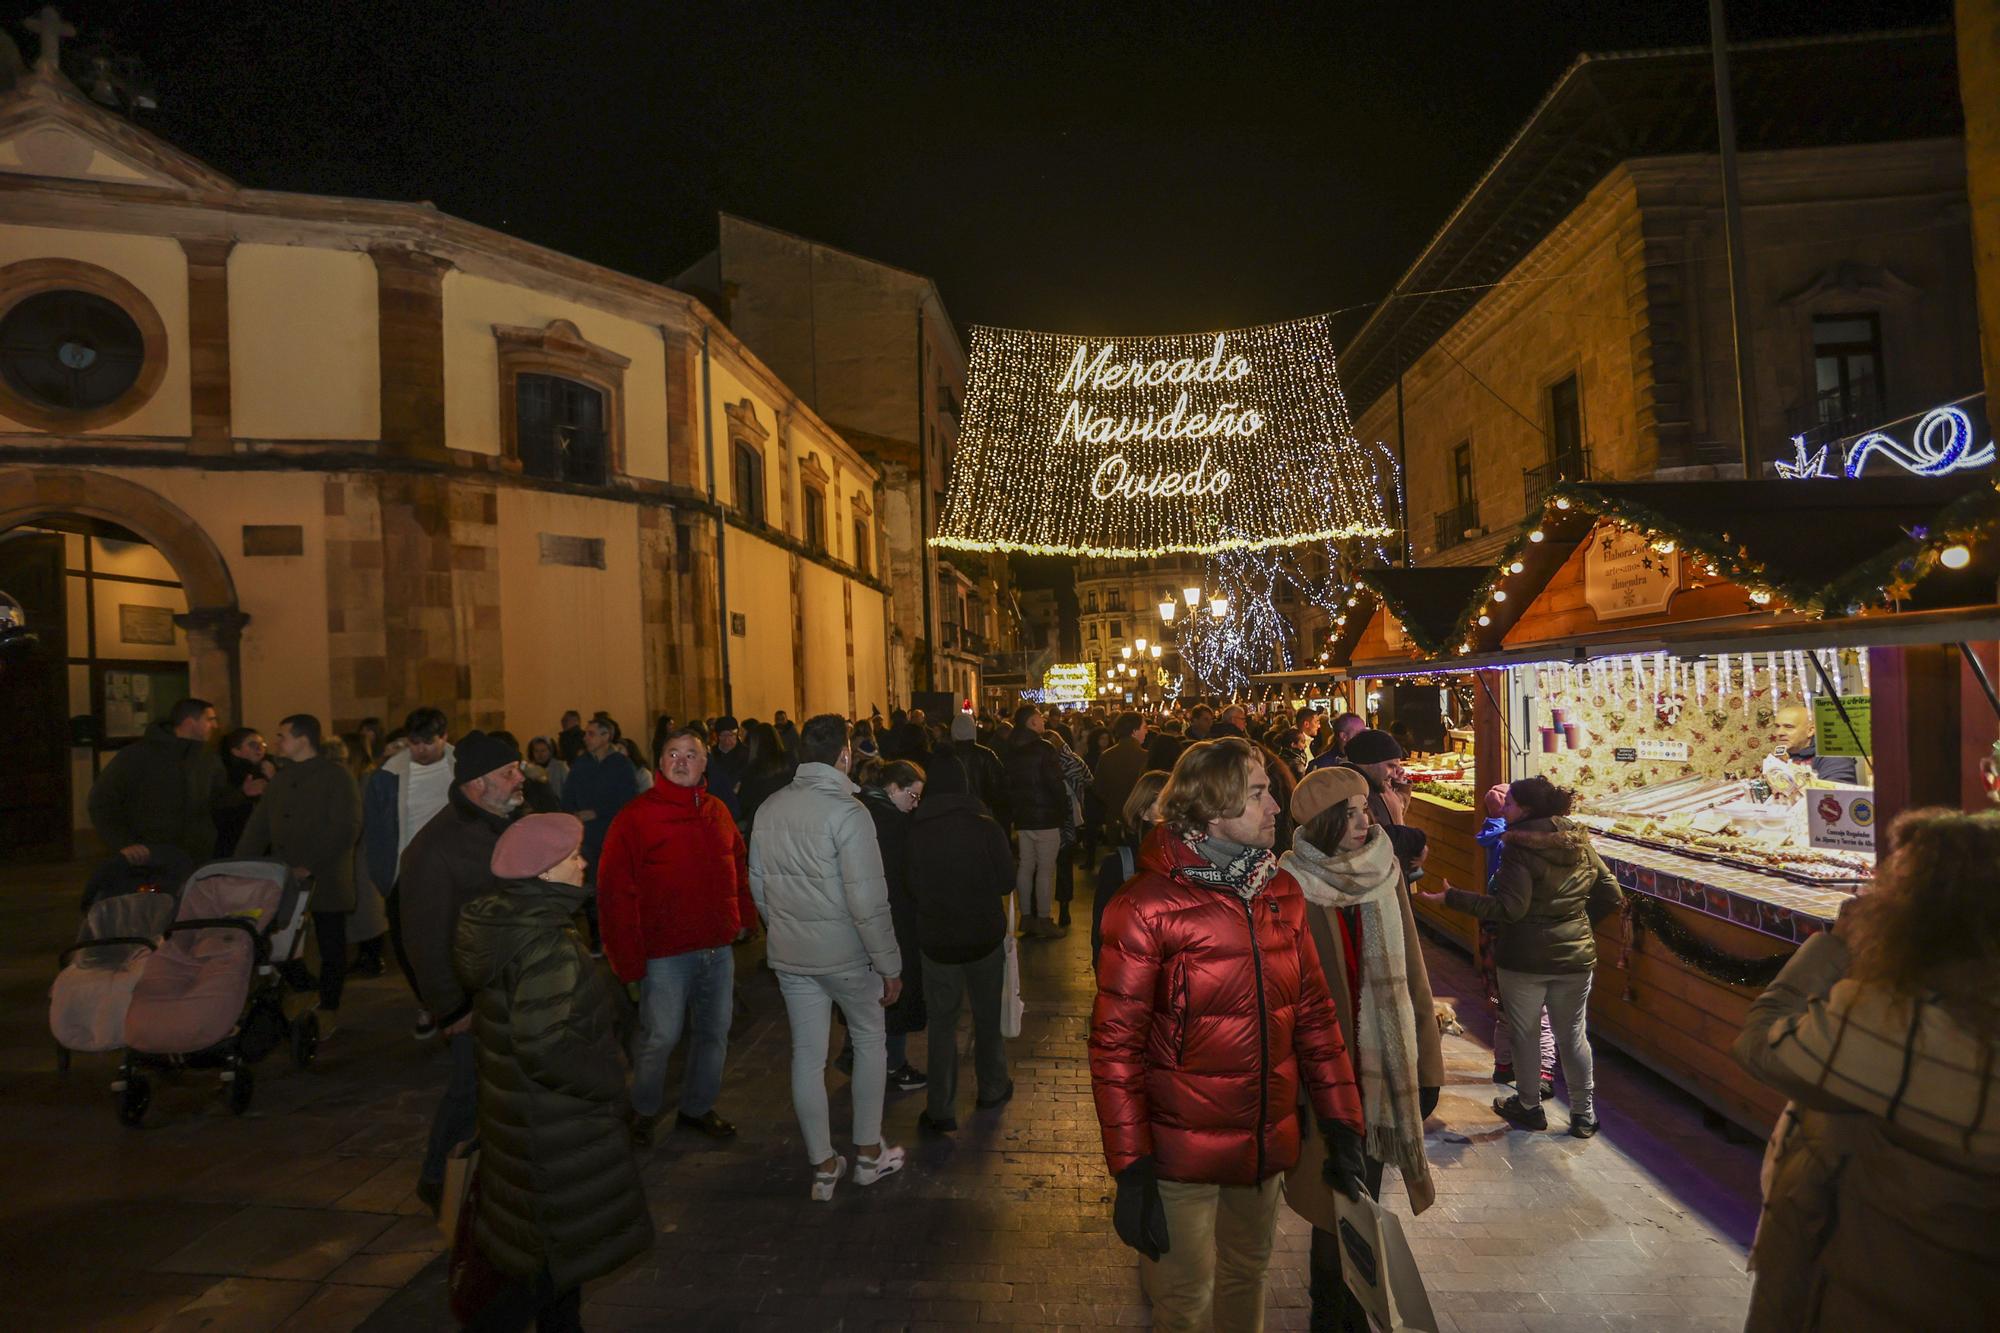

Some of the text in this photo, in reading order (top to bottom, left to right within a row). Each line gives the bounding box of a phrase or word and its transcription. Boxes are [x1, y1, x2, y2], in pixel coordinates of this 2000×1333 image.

[1056, 334, 1252, 394] Mercado
[1054, 392, 1265, 445] Navideño
[1091, 447, 1233, 500] Oviedo
[1603, 544, 1648, 562] Elaborador
[1611, 575, 1647, 590] almendra
